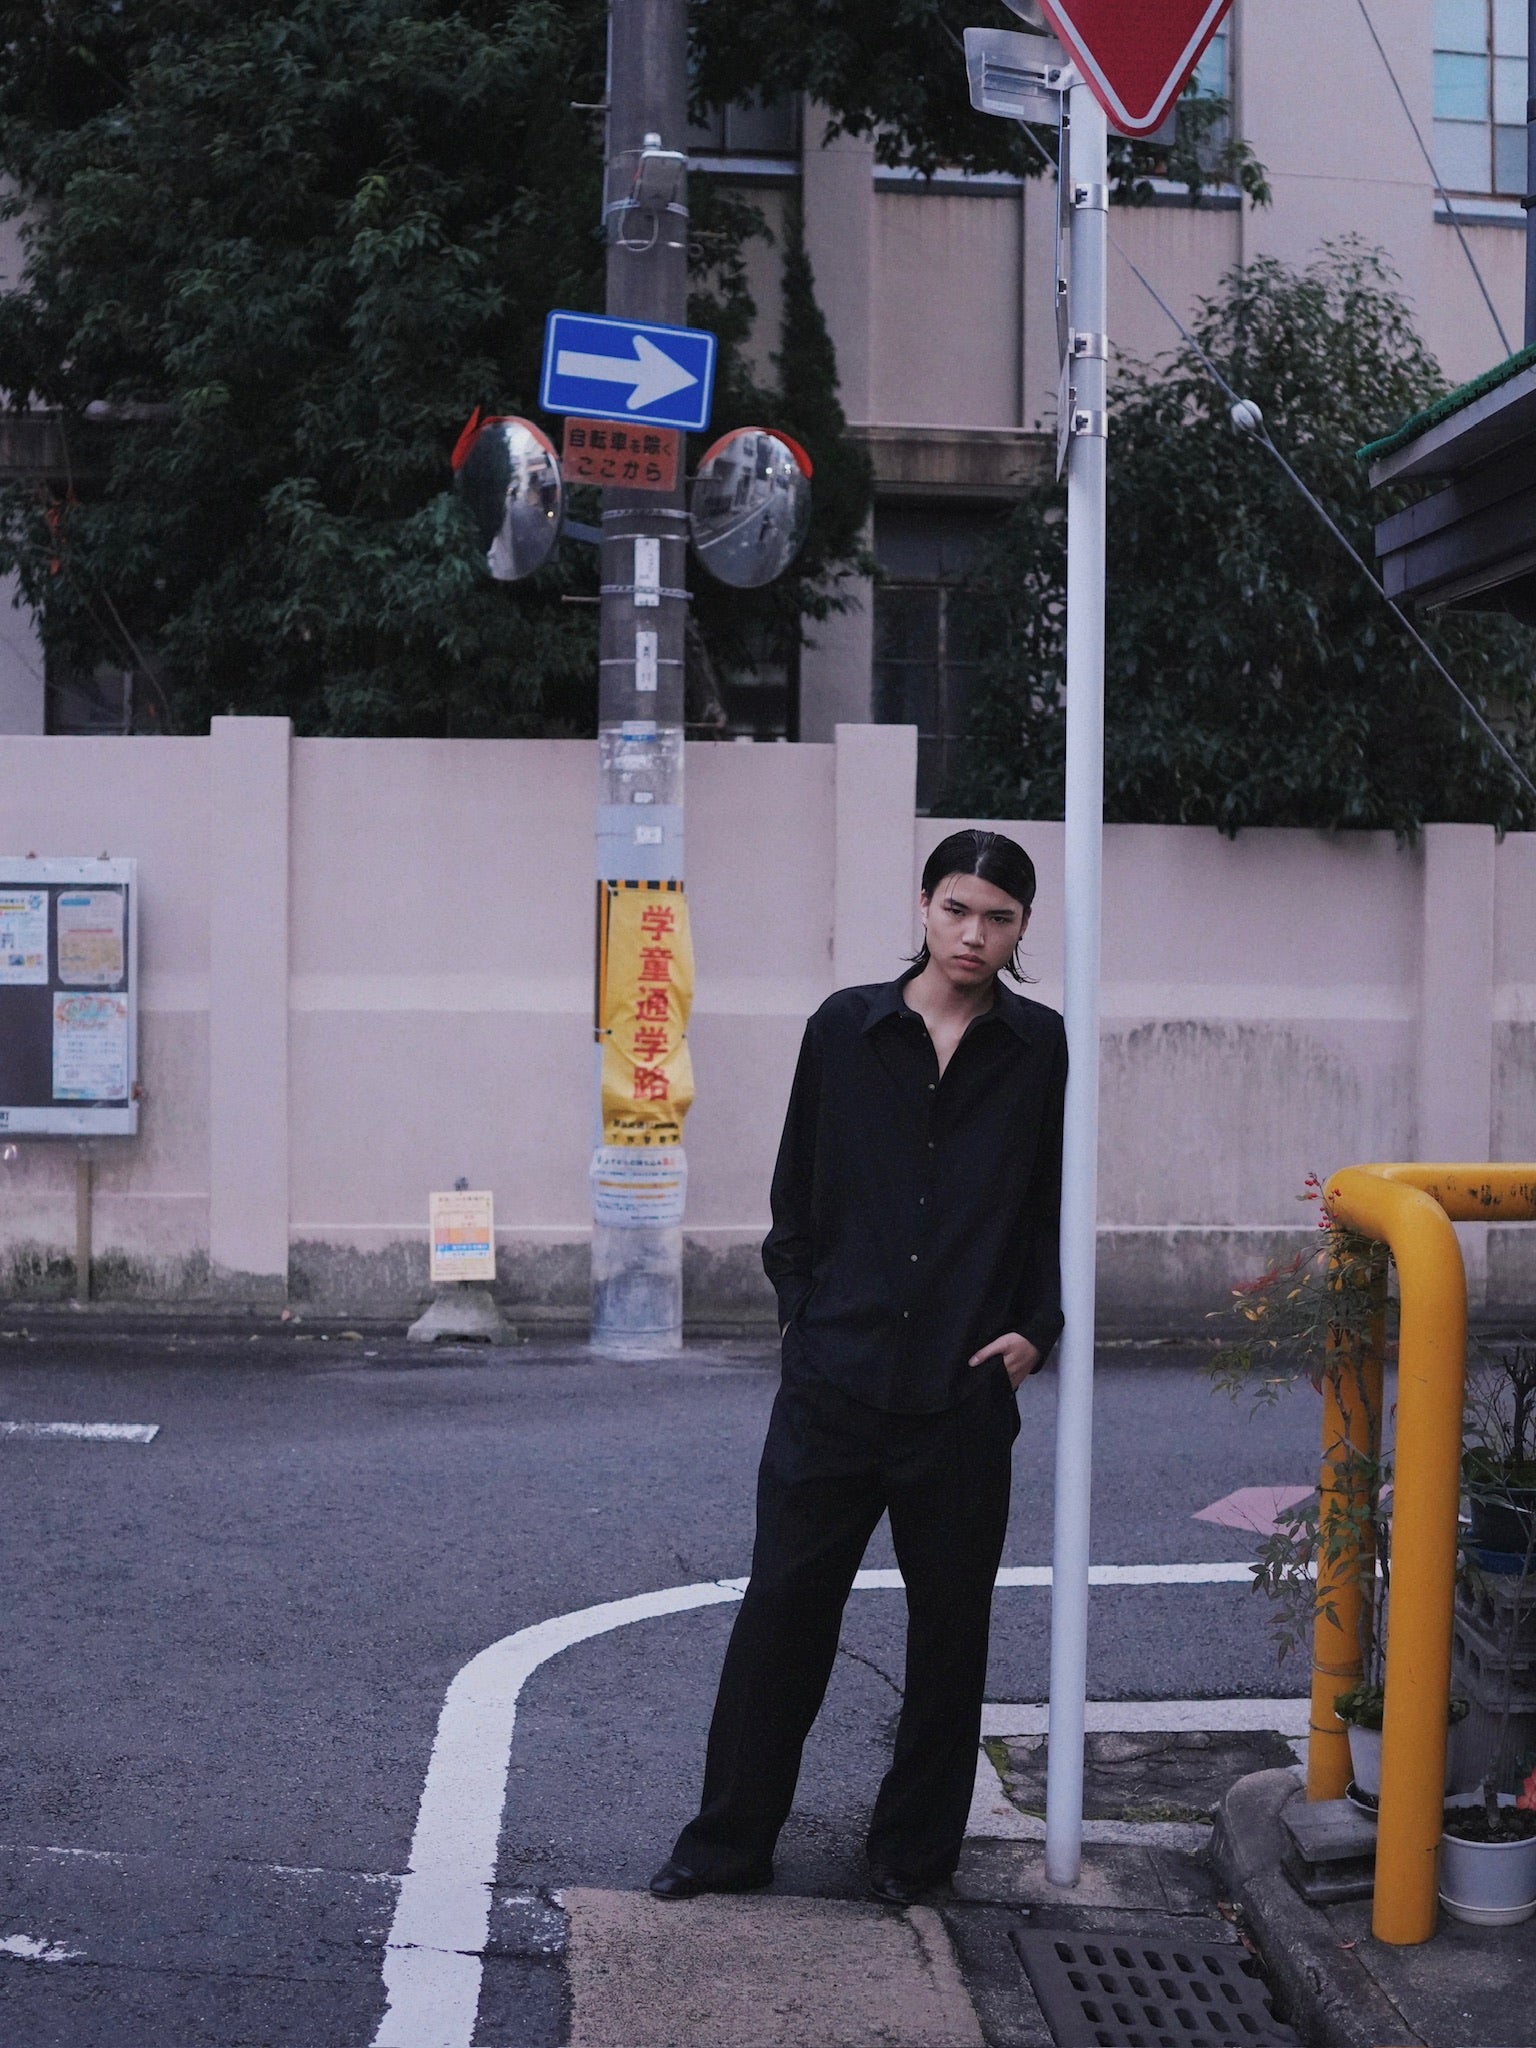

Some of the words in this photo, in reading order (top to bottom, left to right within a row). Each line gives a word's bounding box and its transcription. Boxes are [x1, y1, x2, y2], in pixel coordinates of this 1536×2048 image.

[569, 428, 673, 457] 自転車を除く
[578, 456, 662, 482] ここから
[633, 905, 675, 1101] 学童通学路
